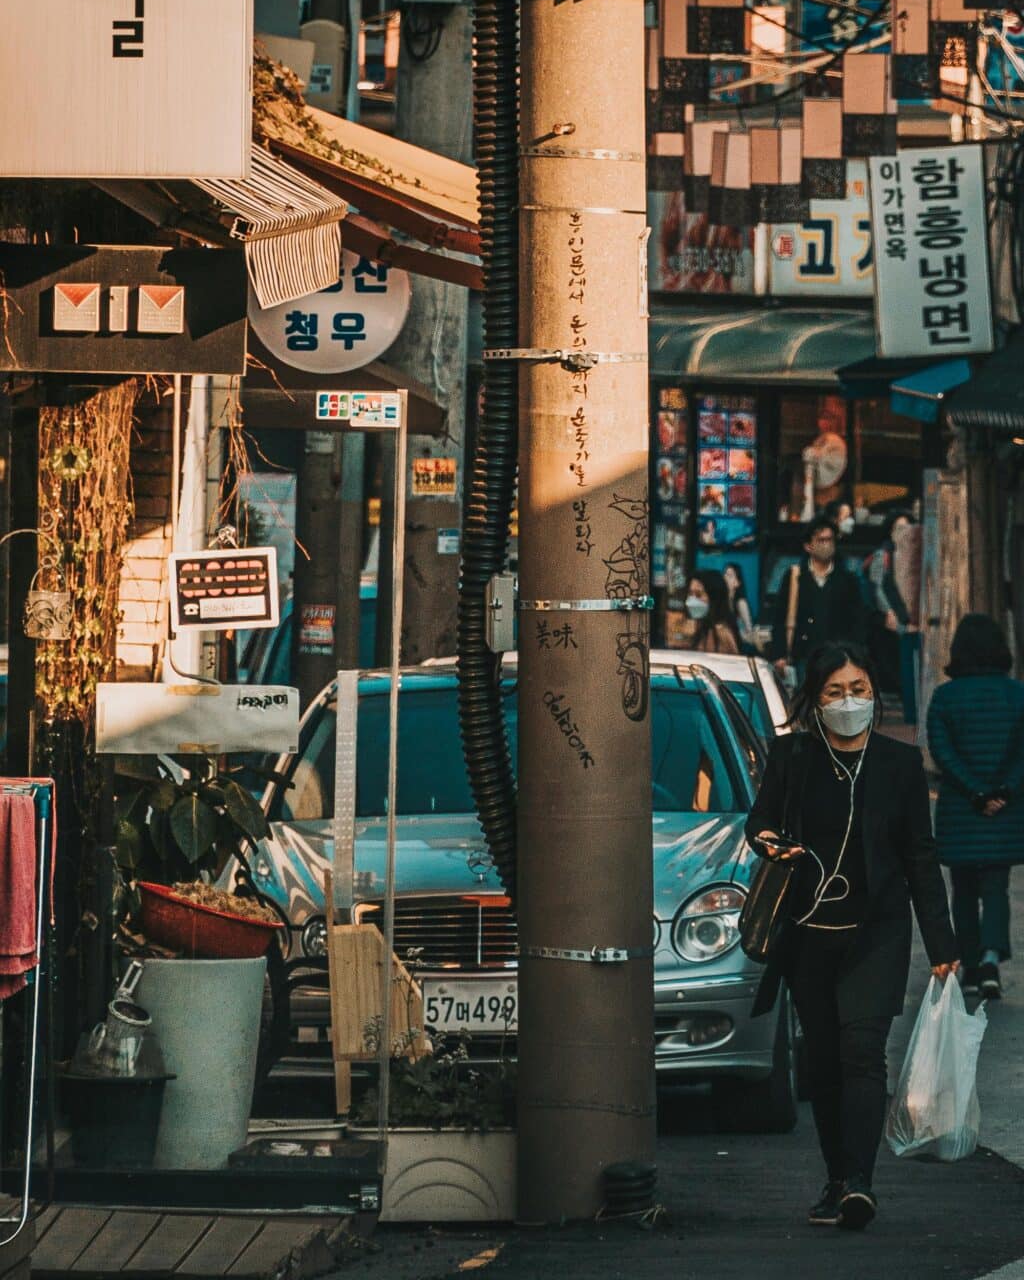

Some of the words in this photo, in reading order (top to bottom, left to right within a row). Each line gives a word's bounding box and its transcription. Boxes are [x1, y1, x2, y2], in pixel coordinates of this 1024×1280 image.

[911, 157, 971, 346] 함흥냉면
[318, 257, 392, 293] 산
[285, 310, 366, 351] 청우
